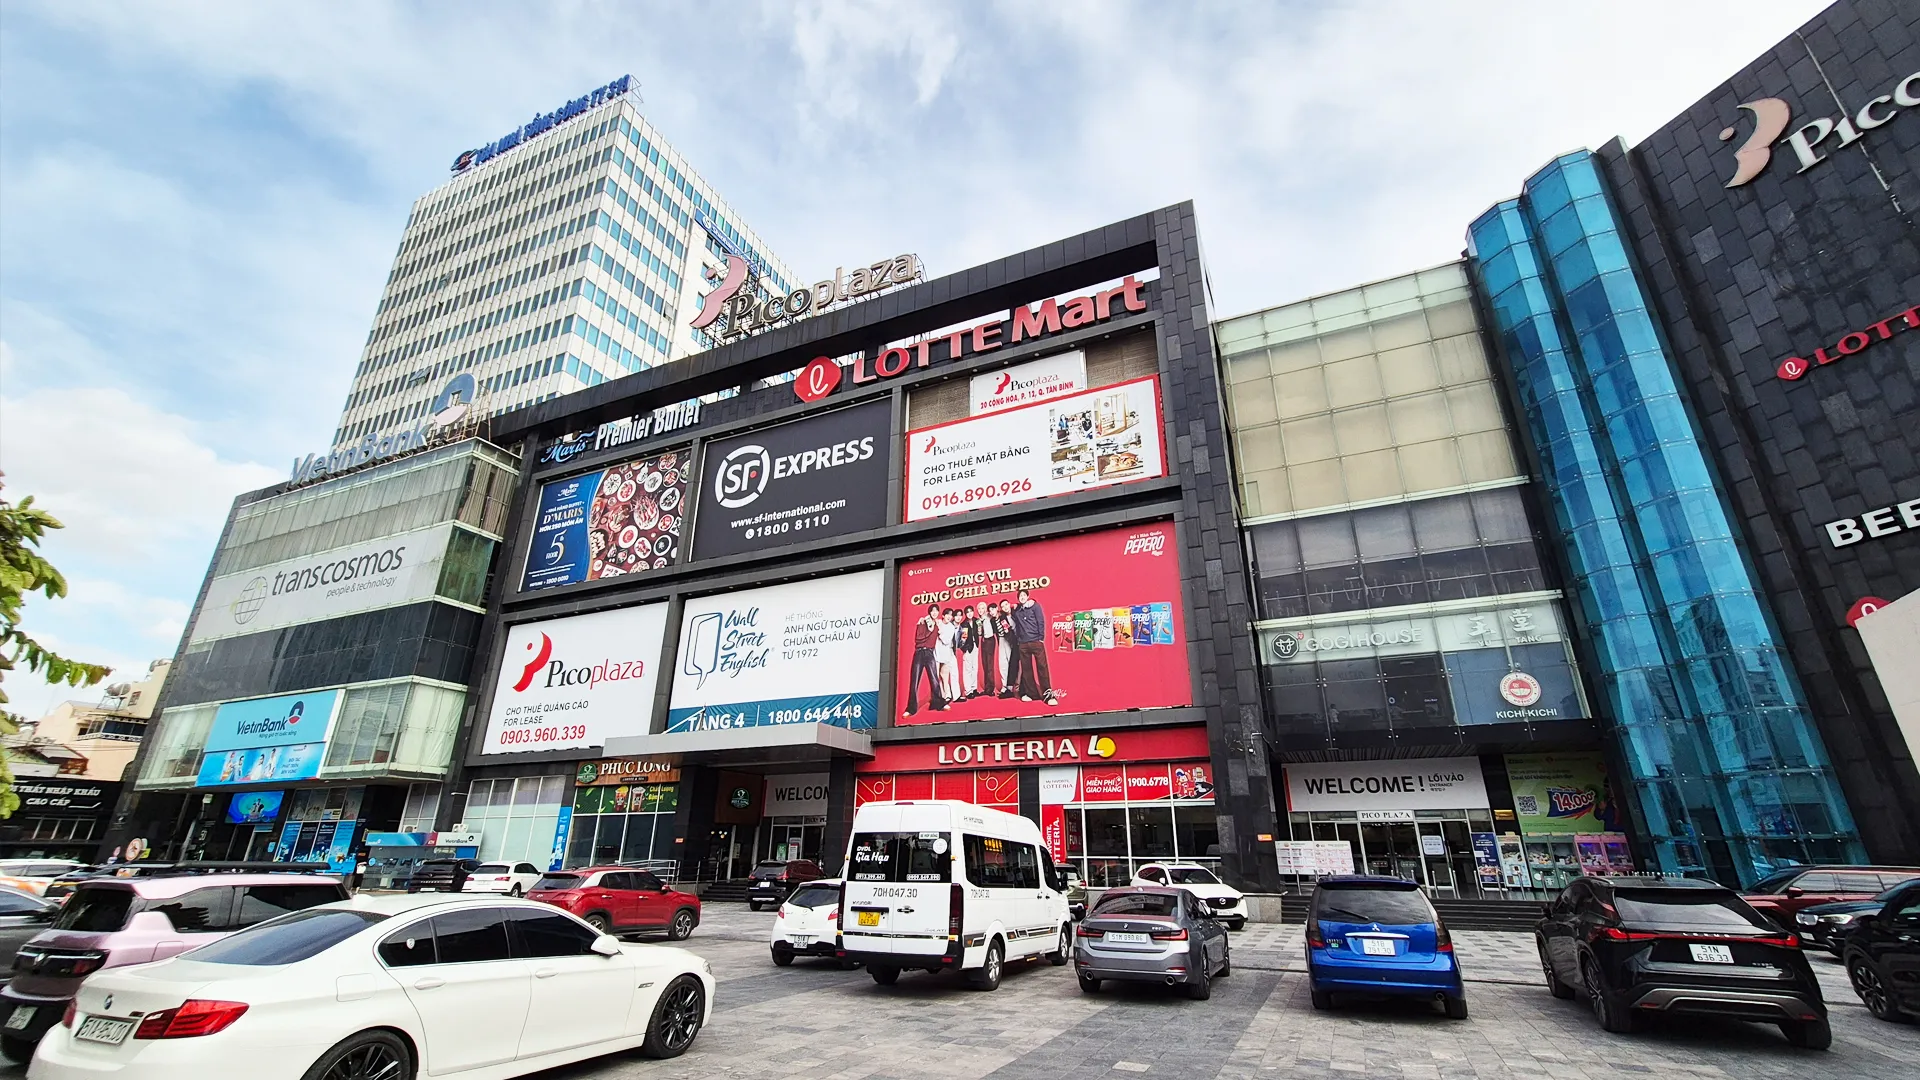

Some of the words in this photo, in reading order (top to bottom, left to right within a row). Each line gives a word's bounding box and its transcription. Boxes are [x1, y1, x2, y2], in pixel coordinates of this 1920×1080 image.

[721, 253, 916, 338] Picoplaza
[853, 319, 1003, 384] LOTTE
[1011, 275, 1146, 343] Mart
[1010, 374, 1059, 391] Picoplaza
[594, 414, 653, 450] Premier
[653, 402, 701, 435] Buffet
[291, 419, 429, 486] VietinBank
[933, 440, 976, 456] Picoplaza
[724, 459, 761, 494] SF
[773, 436, 874, 480] EXPRESS
[923, 463, 946, 475] CHO
[948, 455, 974, 470] THUÊ
[976, 451, 998, 465] MẶT
[1000, 445, 1030, 460] BẰNG
[923, 476, 943, 486] FOR
[945, 469, 976, 483] LEASE
[922, 478, 1032, 510] 0916.890.926
[730, 499, 846, 529] www.sf-international.com
[756, 521, 790, 538] 1800
[794, 514, 830, 531] 8110
[1124, 534, 1166, 556] PEPERO
[271, 546, 406, 596] transcosmos
[914, 567, 933, 575] LOTTE
[945, 572, 985, 588] CÙNG
[986, 568, 1012, 580] VUI
[326, 584, 350, 600] people
[356, 576, 398, 592] technology
[910, 590, 950, 605] CÙNG
[953, 584, 989, 600] CHIA
[991, 576, 1051, 594] PEPERO
[724, 606, 760, 630] Wall
[784, 623, 806, 635] ANH
[806, 619, 830, 633] NGỮ
[830, 616, 856, 630] TOÀN
[858, 612, 880, 626] CẦU
[796, 610, 824, 620] THỐNG
[1074, 620, 1092, 628] EPERO
[1113, 616, 1130, 624] EPERO
[1132, 613, 1150, 622] EPERO
[1152, 610, 1170, 620] EPERO
[1052, 621, 1073, 630] PEPERO
[721, 630, 768, 651] Street
[782, 634, 816, 648] CHUẨN
[818, 630, 844, 646] CHÂU
[846, 630, 861, 641] ÂU
[1305, 636, 1354, 651] GOGI
[1356, 628, 1423, 646] HOUSE
[1516, 635, 1542, 643] TANG
[782, 650, 796, 660] TỪ
[796, 648, 819, 660] 1972
[720, 648, 770, 679] English
[543, 658, 644, 691] Picoplaza
[506, 706, 522, 716] CHO
[524, 702, 542, 714] THUÊ
[543, 702, 570, 712] QUẢNG
[572, 698, 589, 710] CÁO
[768, 709, 800, 724] 1800
[803, 706, 830, 722] 646
[832, 704, 862, 719] 448
[1496, 708, 1558, 719] KICHI-KICHI
[236, 716, 288, 735] VietinBank
[503, 718, 519, 728] FOR
[520, 715, 544, 726] LEASE
[734, 712, 745, 728] 4
[500, 724, 586, 745] 0903.960.339
[938, 738, 1079, 765] LOTTERIA
[636, 761, 671, 773] LONG
[1086, 776, 1103, 786] MIỄN
[1104, 777, 1115, 786] PHÍ
[1128, 777, 1169, 787] 1900.6778
[1304, 776, 1416, 795] WELCOME
[1418, 775, 1425, 792] !
[1428, 772, 1442, 782] LỐI
[1444, 772, 1464, 782] VÀO
[50, 797, 71, 806] CẤP
[1383, 811, 1411, 819] PLAZA
[855, 852, 870, 863] Gia
[1697, 953, 1729, 962] 636.33
[1700, 945, 1720, 954] 51N
